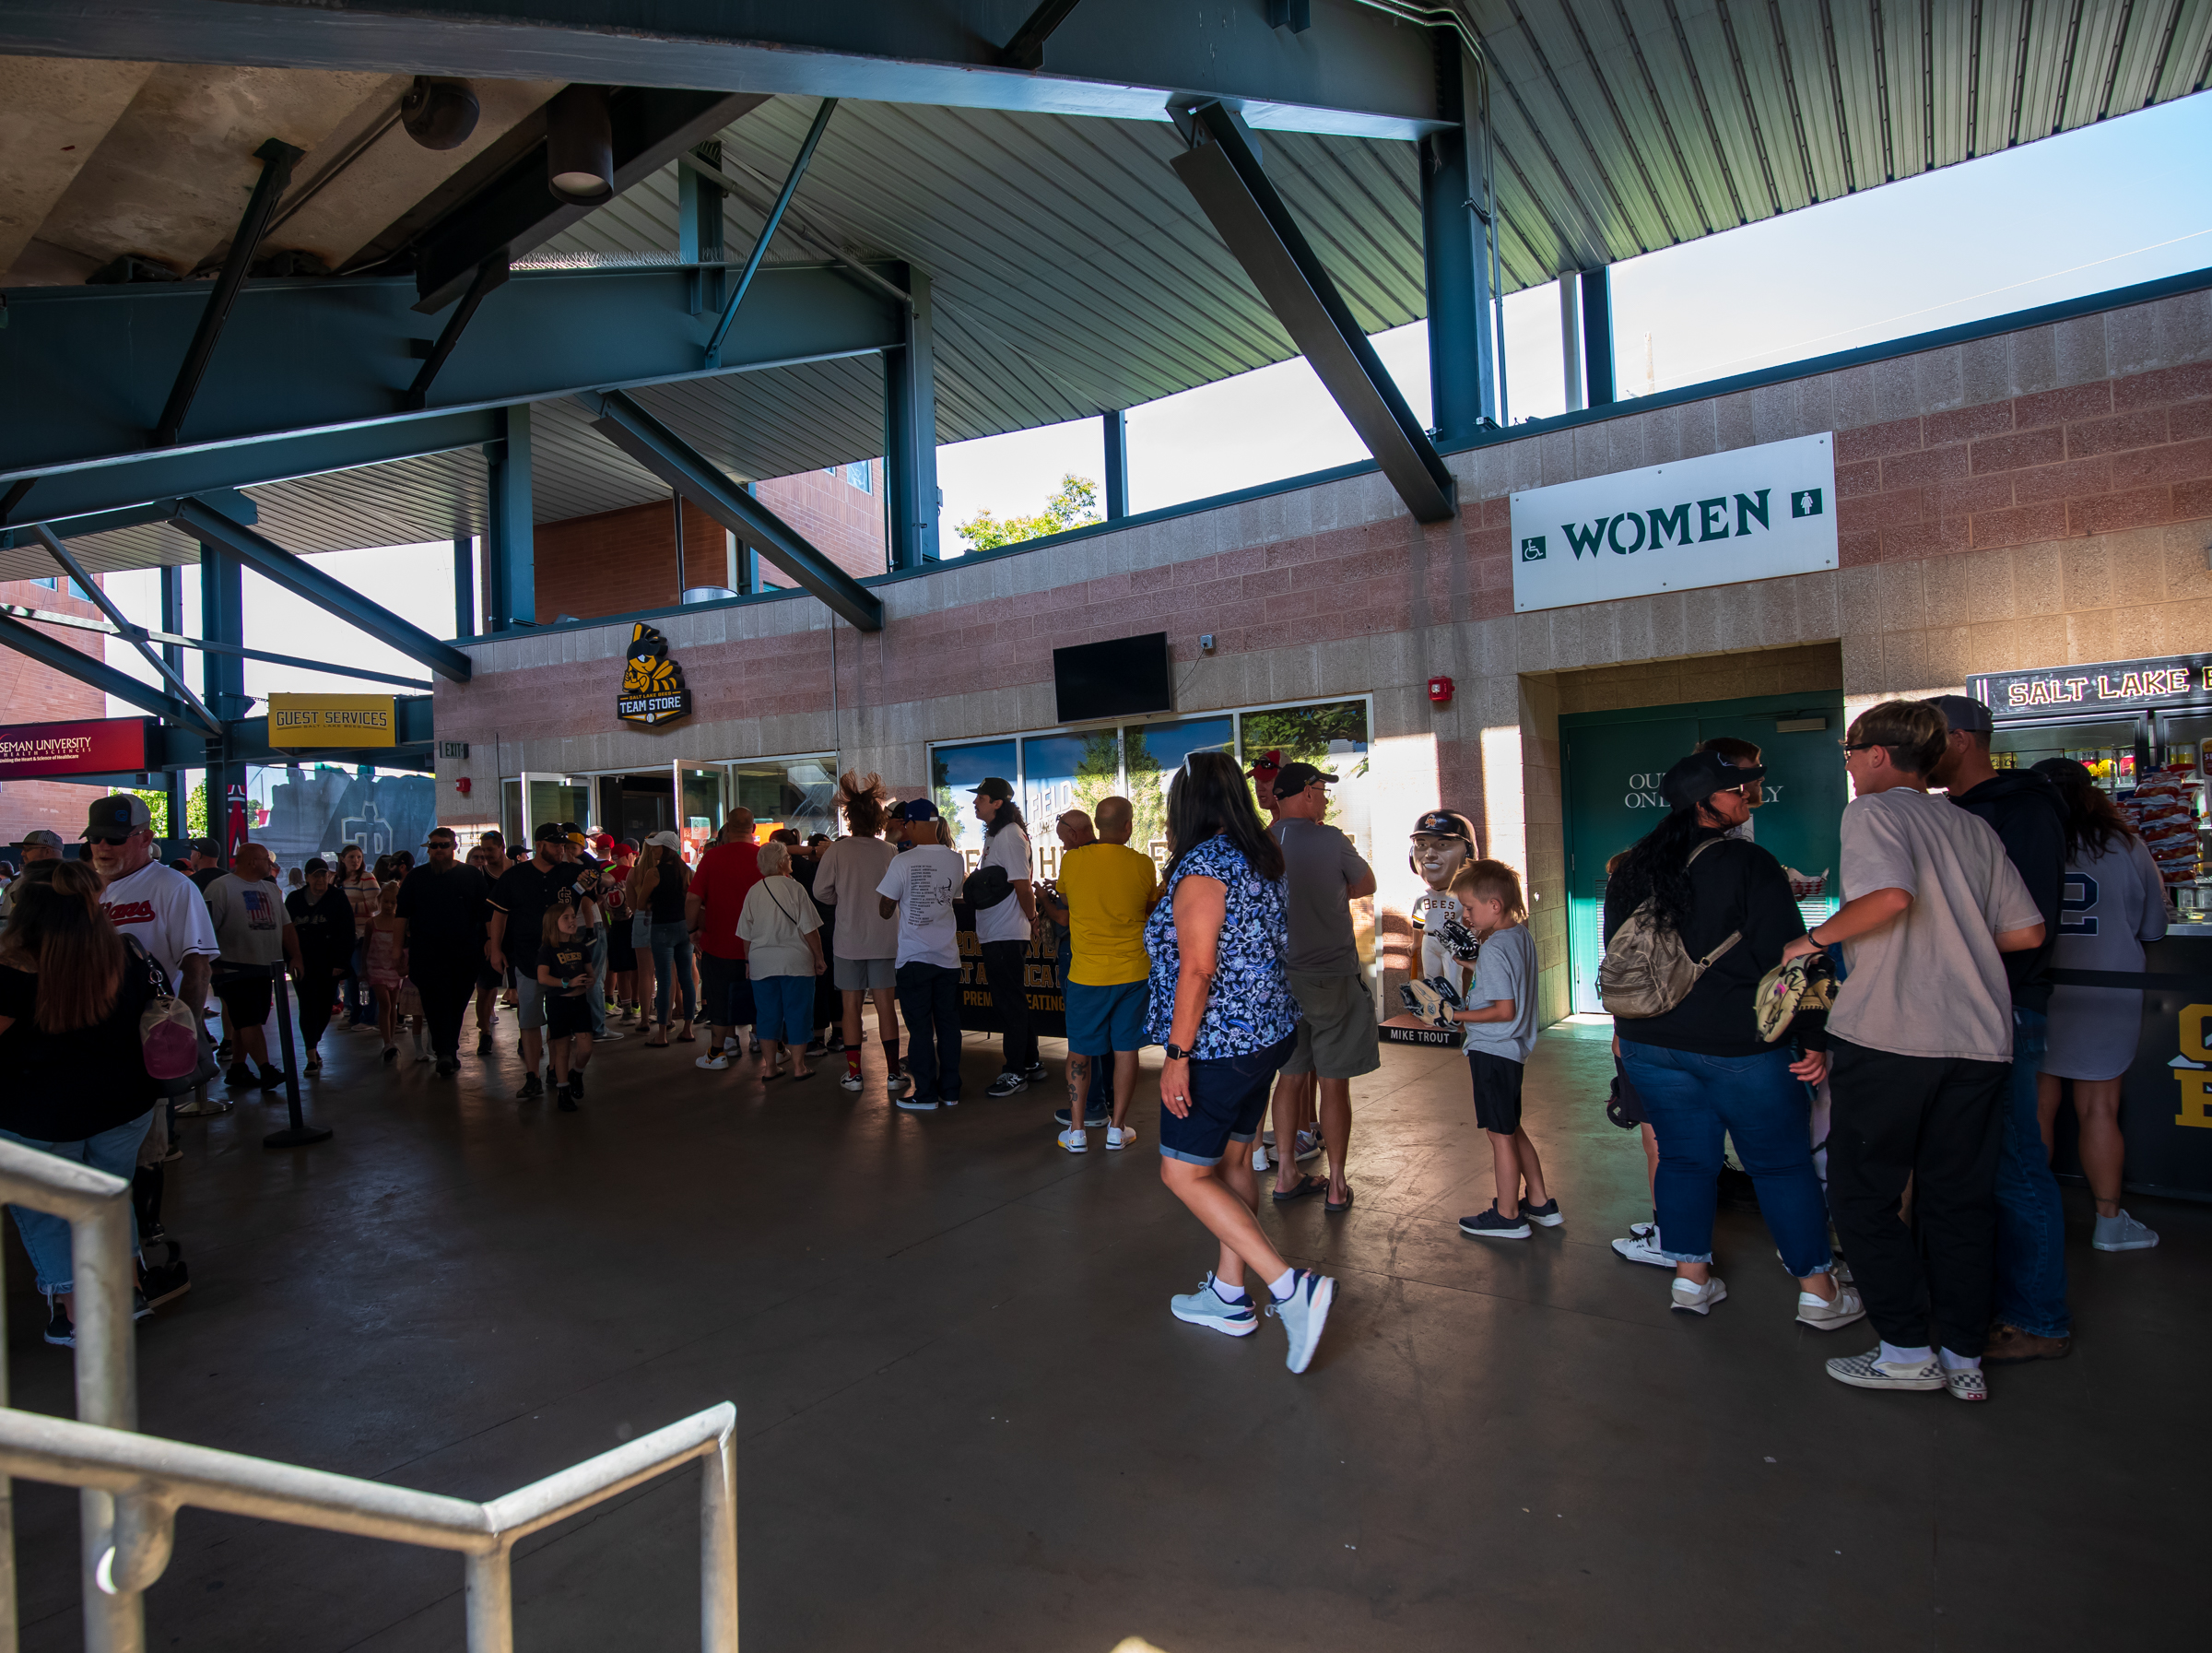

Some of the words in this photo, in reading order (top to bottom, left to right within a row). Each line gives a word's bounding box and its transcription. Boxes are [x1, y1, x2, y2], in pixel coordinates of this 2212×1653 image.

[1561, 489, 1771, 561] WOMEN
[2008, 677, 2088, 706] SALT
[2098, 668, 2190, 699] LAKE
[619, 700, 647, 714] TEAM
[648, 696, 681, 711] STORE
[276, 711, 319, 726] GUEST
[324, 711, 387, 726] SERVICES
[36, 737, 91, 750] UNIVERSITY
[45, 747, 91, 755] SCIENCES
[445, 742, 461, 757] EXIT
[1629, 773, 1666, 790] OU
[1029, 780, 1072, 823] FIELD
[1624, 792, 1671, 809] ONL
[1423, 898, 1455, 910] BEES
[1444, 911, 1456, 920] 23
[557, 951, 582, 964] BEES
[1025, 993, 1065, 1012] EATING
[1391, 1029, 1414, 1041] MIKE
[1418, 1031, 1450, 1044] TROUT
